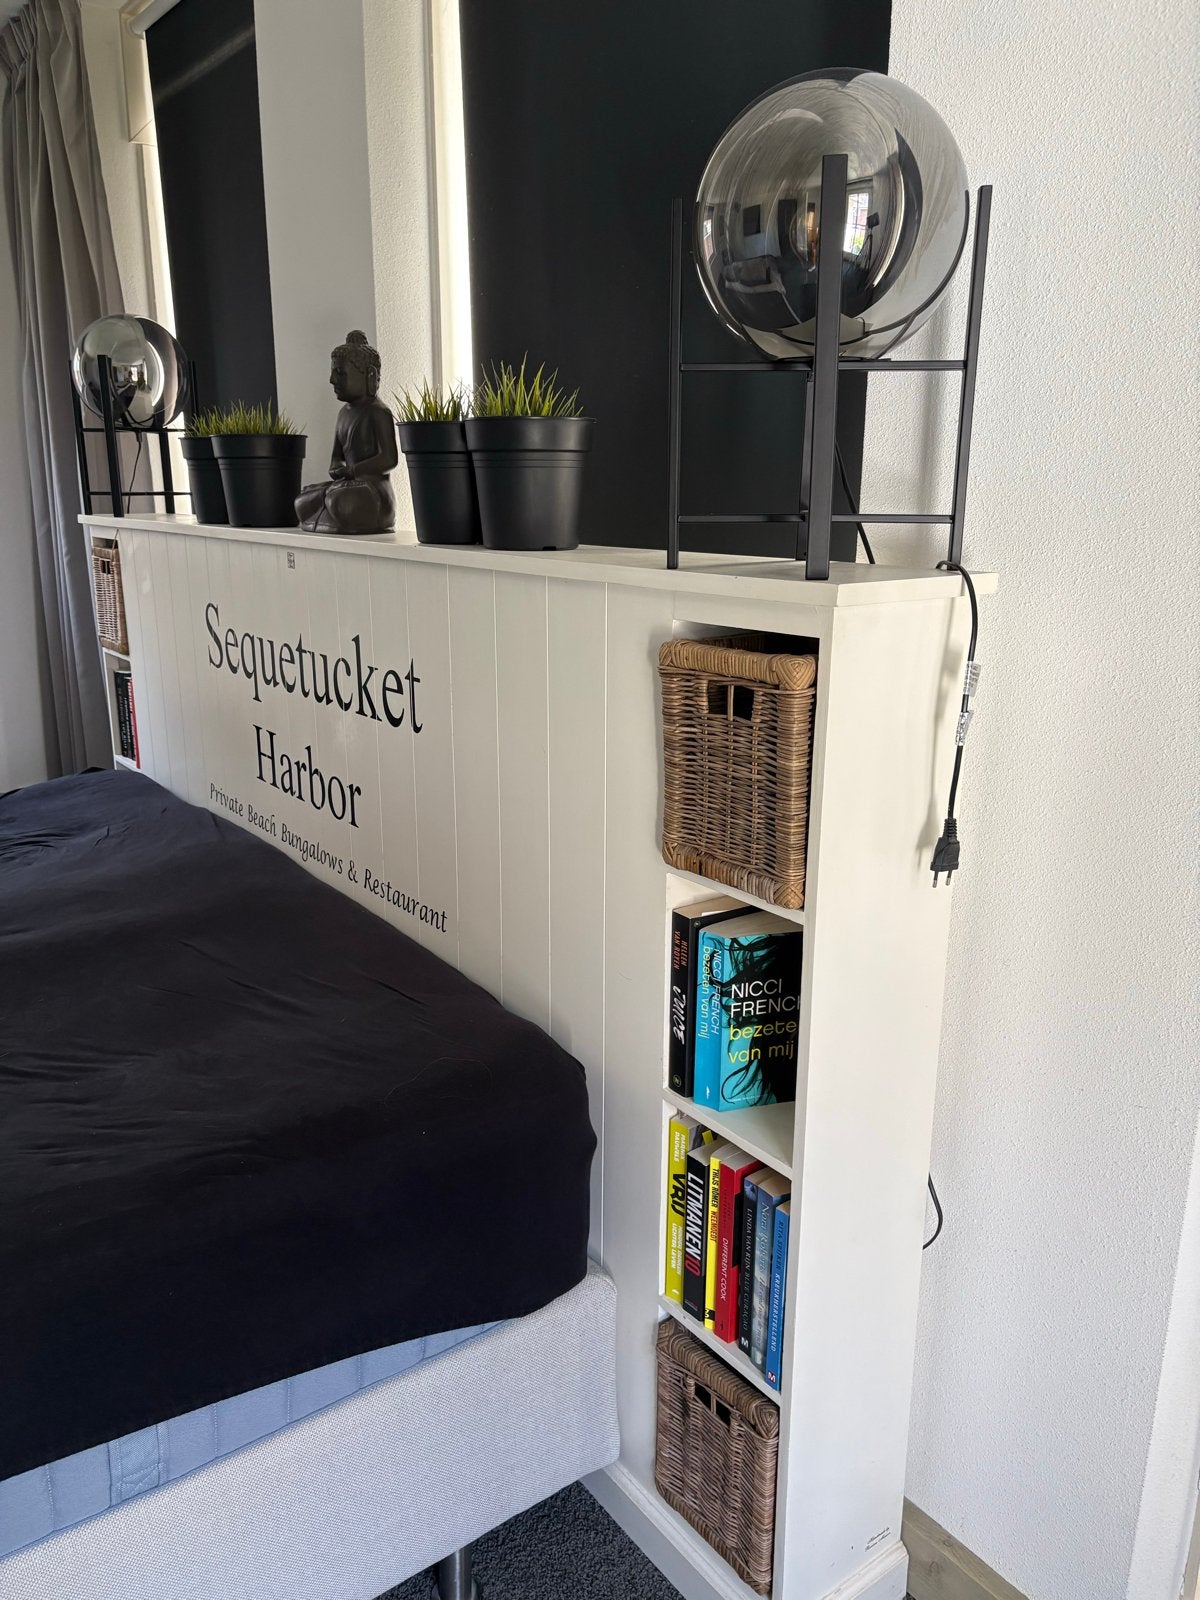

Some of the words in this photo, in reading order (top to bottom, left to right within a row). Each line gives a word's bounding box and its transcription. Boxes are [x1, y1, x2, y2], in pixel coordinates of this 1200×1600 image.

[205, 602, 423, 733] Sequetucket
[253, 724, 361, 828] Harbor
[210, 782, 244, 817] Private
[247, 804, 277, 837] Beach
[281, 823, 343, 874] Bungalows
[347, 860, 358, 884] &
[364, 868, 448, 933] Restaurant
[702, 945, 711, 994] bezeten
[712, 948, 722, 981] NICCI
[701, 998, 710, 1018] van
[711, 981, 721, 1035] FRENCH
[731, 978, 782, 999] NICCI
[672, 985, 686, 1046] JUICE
[697, 1021, 709, 1039] mij
[730, 1020, 797, 1041] bezete
[729, 1048, 761, 1063] van
[768, 1040, 794, 1060] mij
[670, 1173, 686, 1217] VRIJ
[761, 1201, 770, 1230] Nora
[721, 1237, 729, 1276] DIFFERENT
[759, 1231, 768, 1272] Roberts
[720, 1276, 728, 1302] COOK
[771, 1273, 780, 1352] KREUKHERSTELLEND
